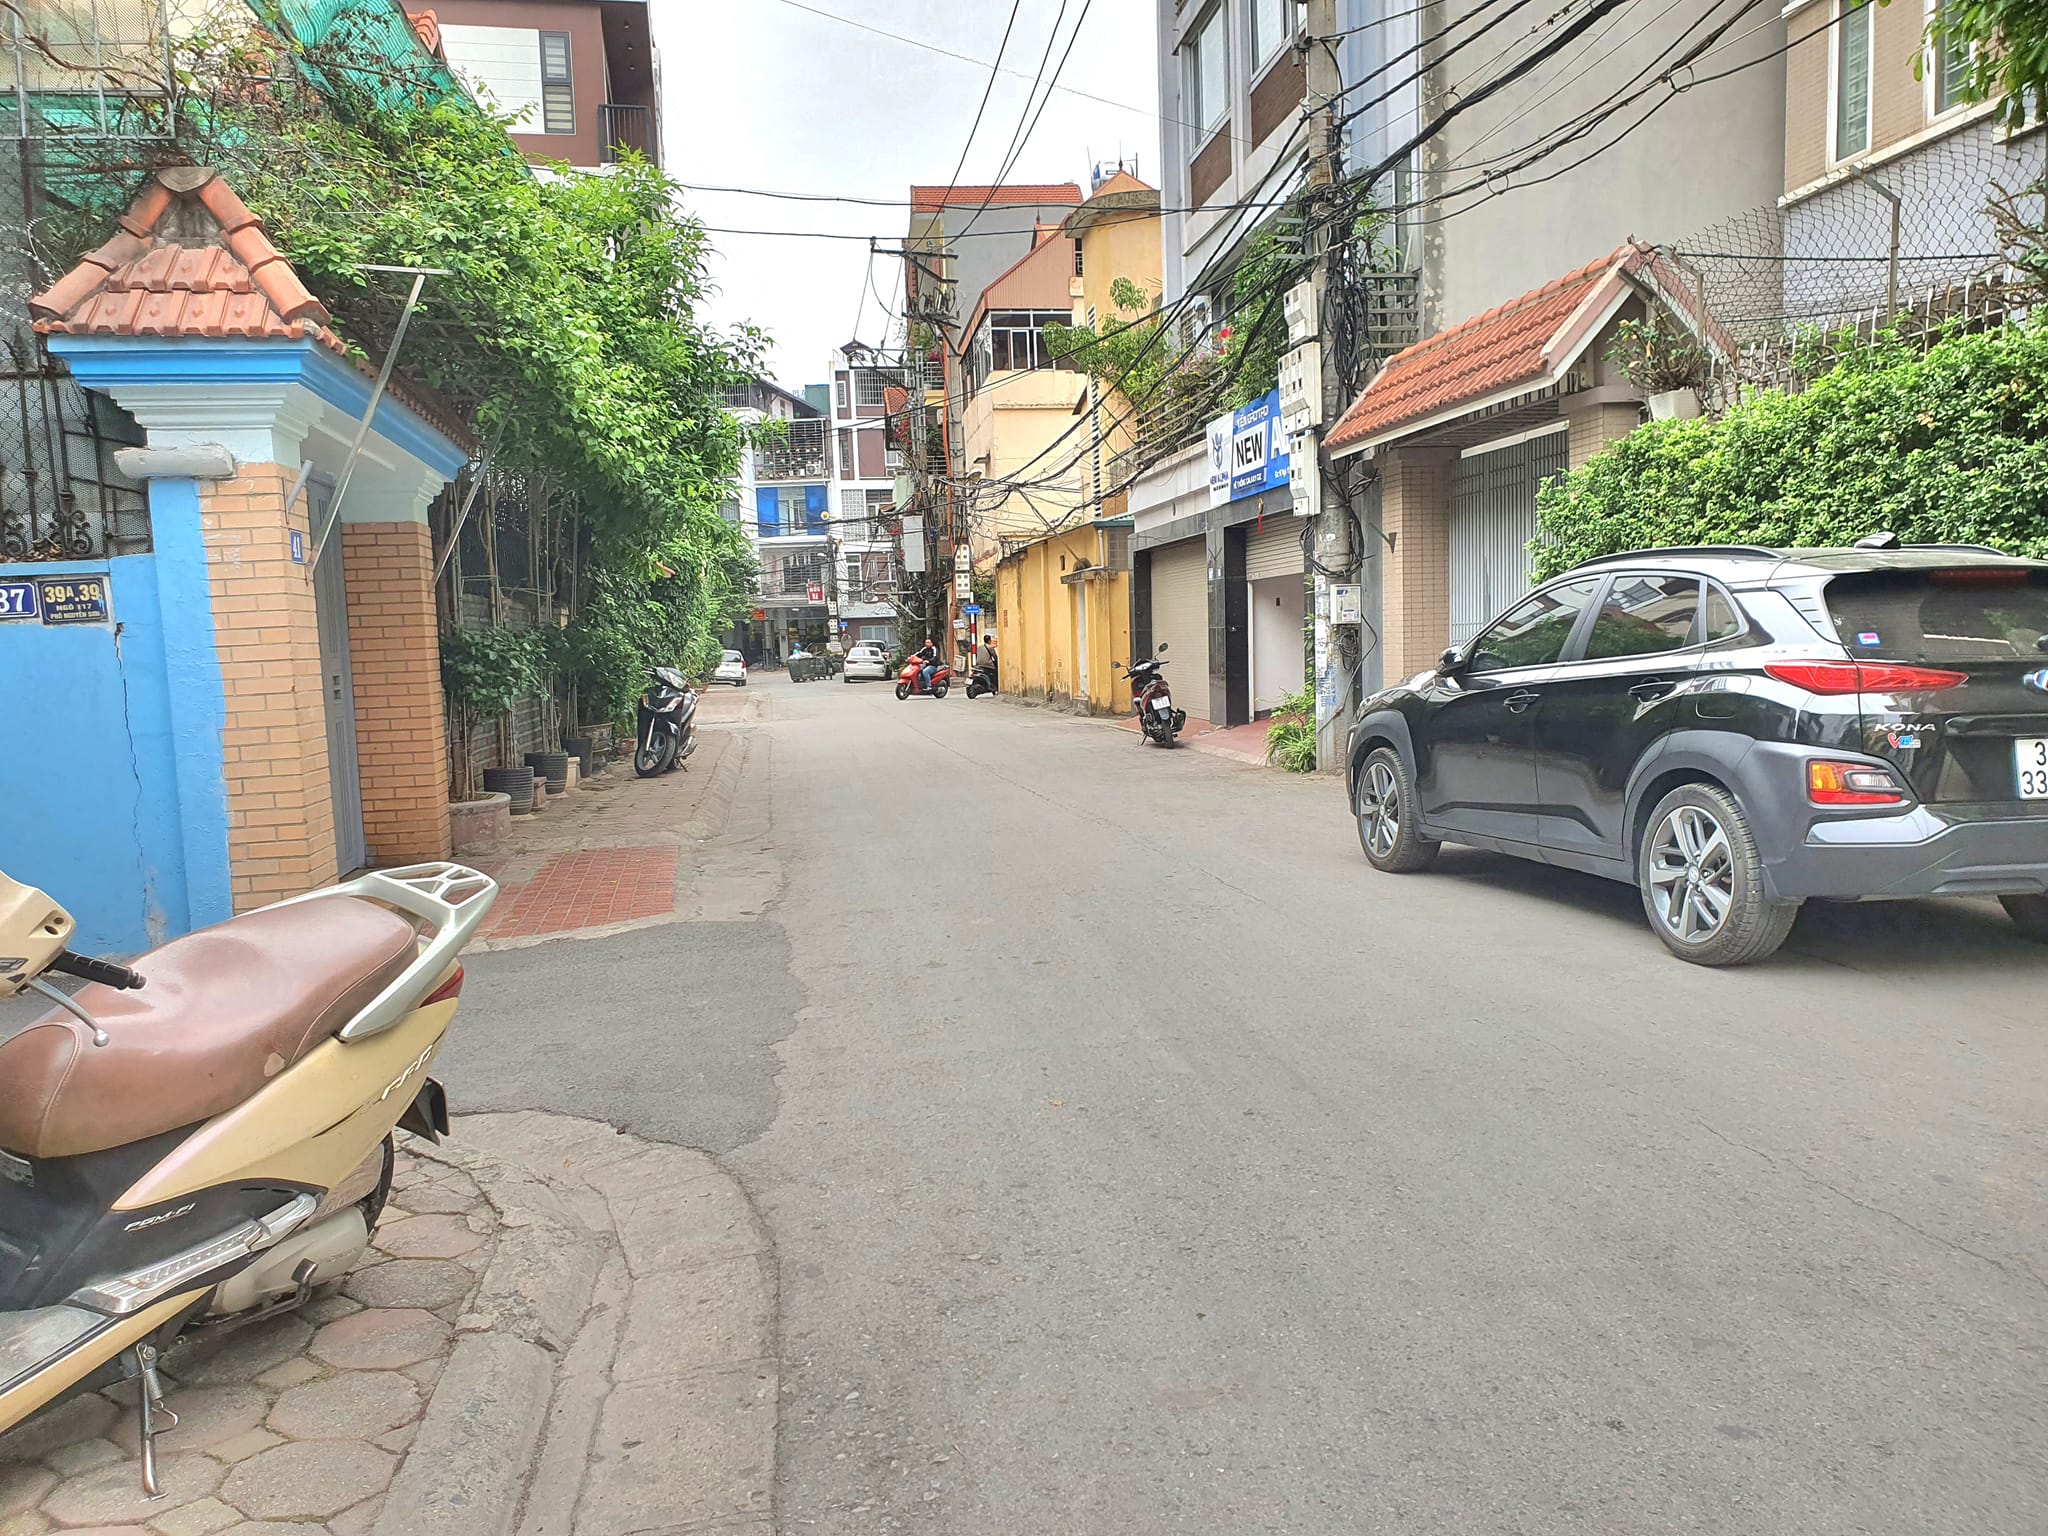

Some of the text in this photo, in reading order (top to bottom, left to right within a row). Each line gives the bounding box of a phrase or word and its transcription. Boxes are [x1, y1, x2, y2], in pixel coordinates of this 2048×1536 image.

[1236, 431, 1263, 468] NEW
[44, 583, 100, 603] 39A.39
[1874, 722, 1936, 732] KONA
